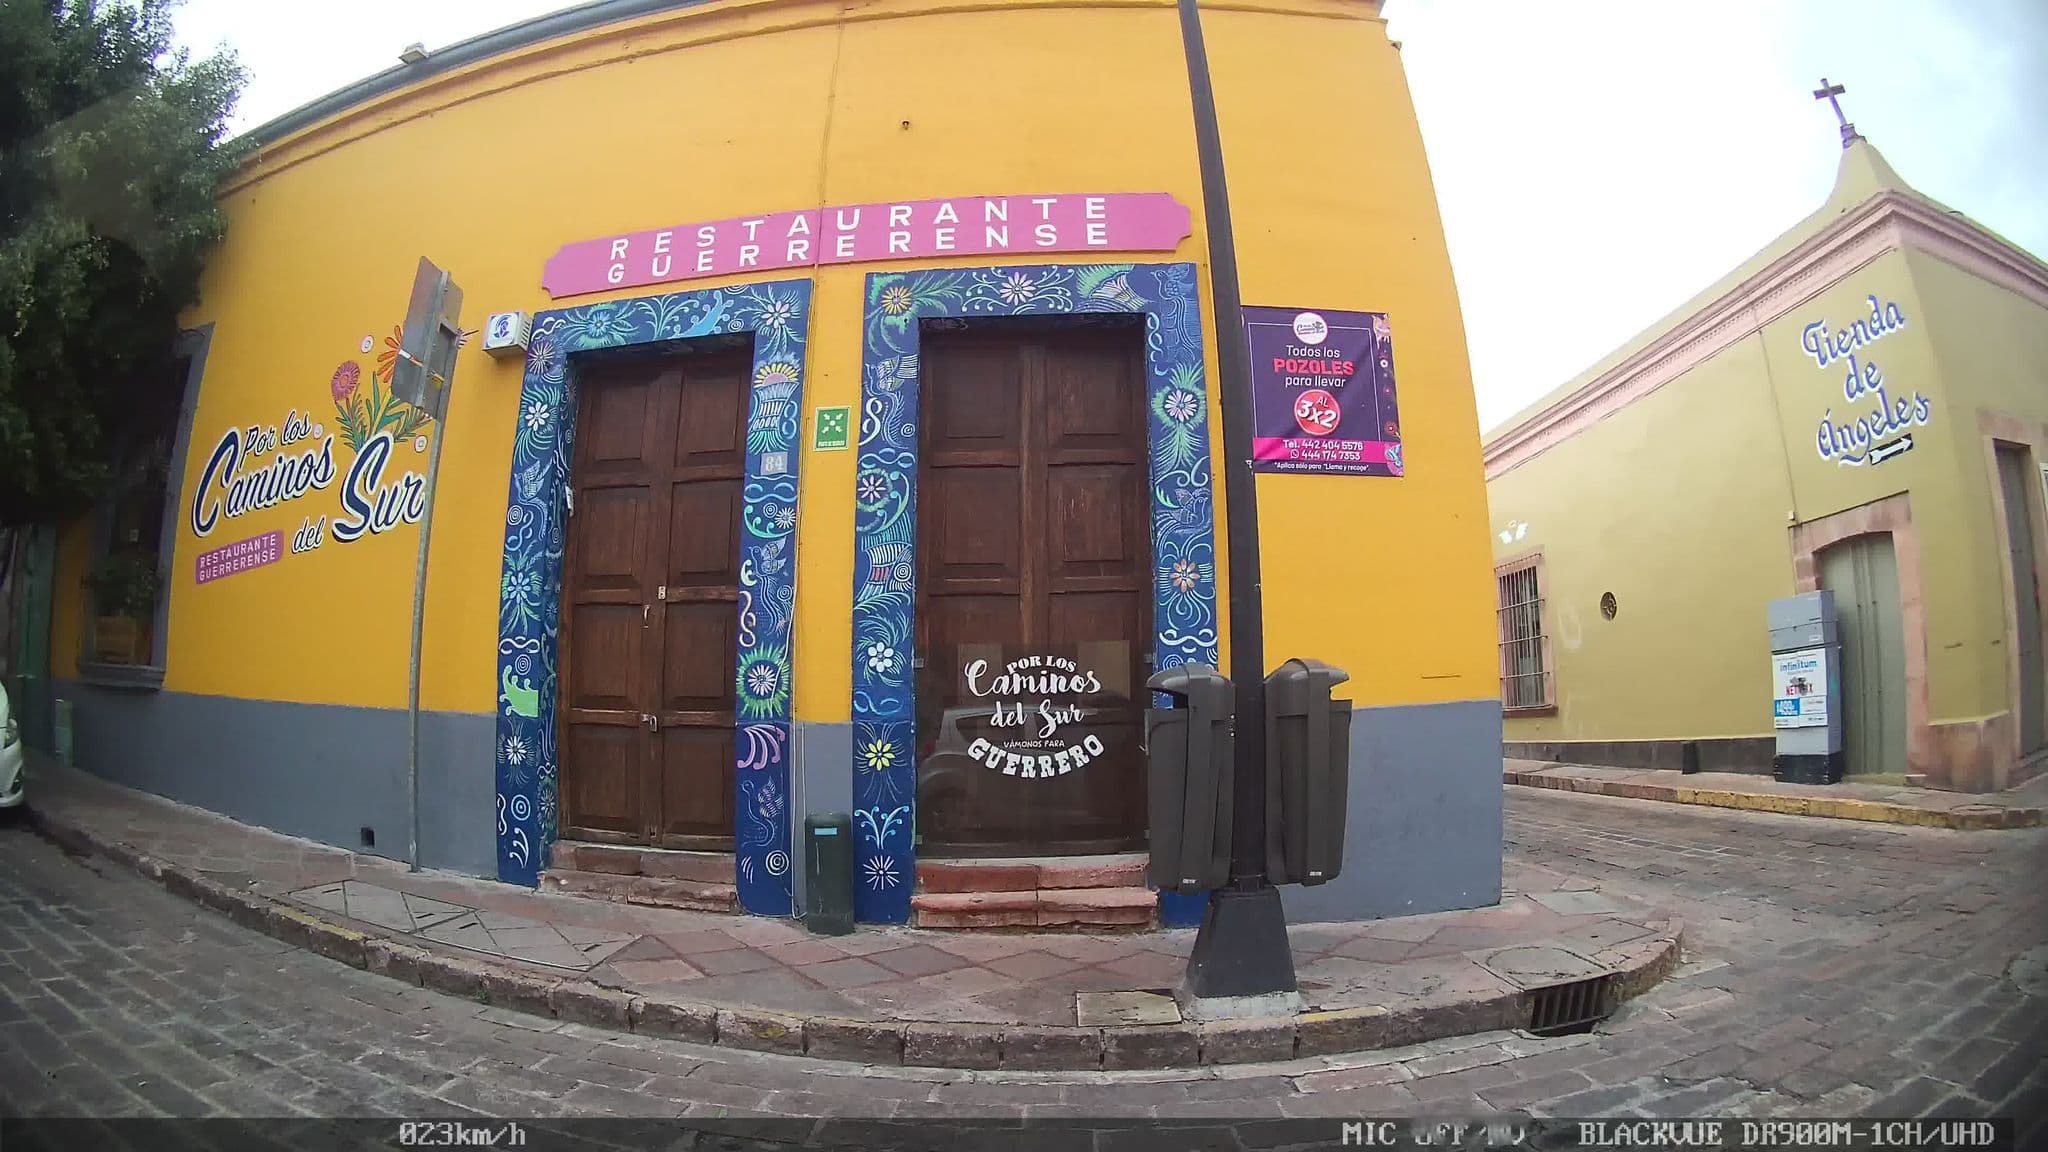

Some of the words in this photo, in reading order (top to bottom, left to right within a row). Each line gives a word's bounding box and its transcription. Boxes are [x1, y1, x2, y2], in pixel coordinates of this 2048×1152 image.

[611, 197, 1106, 261] RESTAURANTE
[607, 223, 1108, 284] GUERRERENSE
[1801, 293, 1905, 368] Tienda
[1273, 357, 1355, 376] POZOLES
[1286, 345, 1321, 357] Todos
[1323, 346, 1341, 358] los
[1285, 376, 1312, 388] para
[1314, 375, 1346, 388] llevar
[1844, 353, 1882, 402] de
[1318, 396, 1329, 407] AL
[238, 425, 276, 472] Por
[281, 408, 311, 445] los
[1283, 439, 1300, 449] Tel.
[1302, 439, 1320, 450] 442
[1322, 440, 1340, 450] 404
[1301, 449, 1320, 460] 444
[1322, 450, 1337, 460] 174
[192, 427, 337, 537] Caminos
[291, 516, 326, 554] del
[332, 431, 426, 543] Sur
[199, 548, 276, 581] GUERRERENSE
[200, 534, 277, 569] RESTAURANTE
[964, 659, 1102, 697] Caminos
[1006, 655, 1042, 675] POR
[1046, 655, 1077, 673] LOS
[990, 701, 1027, 728] del
[1037, 699, 1085, 739] Sur
[967, 734, 1105, 779] GUERRERO
[1044, 739, 1065, 748] PARA
